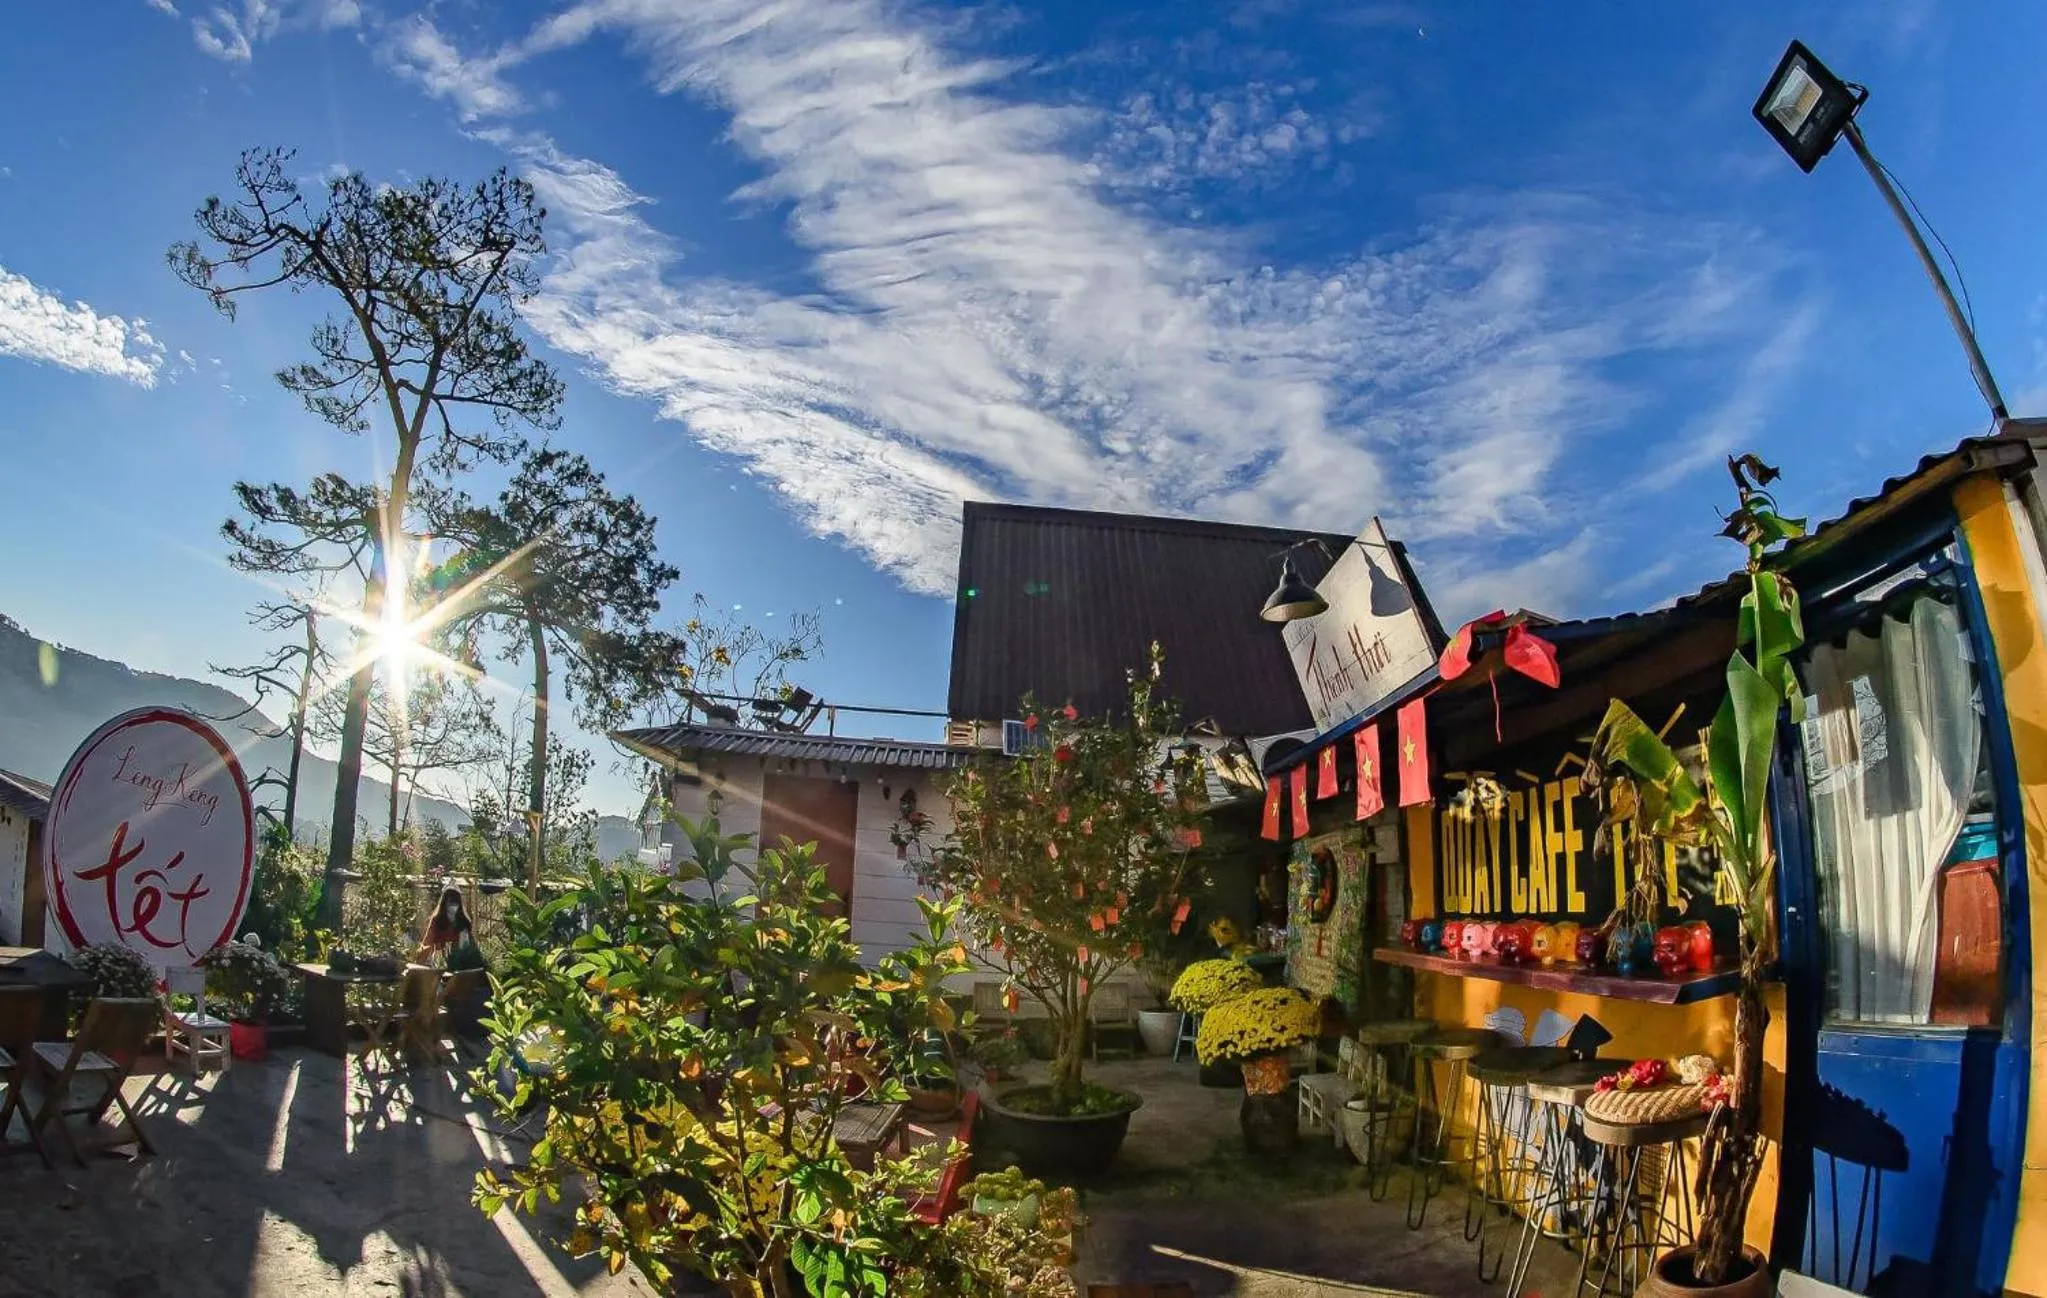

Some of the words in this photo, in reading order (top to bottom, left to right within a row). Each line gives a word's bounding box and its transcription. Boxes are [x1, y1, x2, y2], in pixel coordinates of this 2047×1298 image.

[112, 745, 164, 813] Leng
[165, 762, 219, 827] Keng
[72, 821, 210, 959] tết
